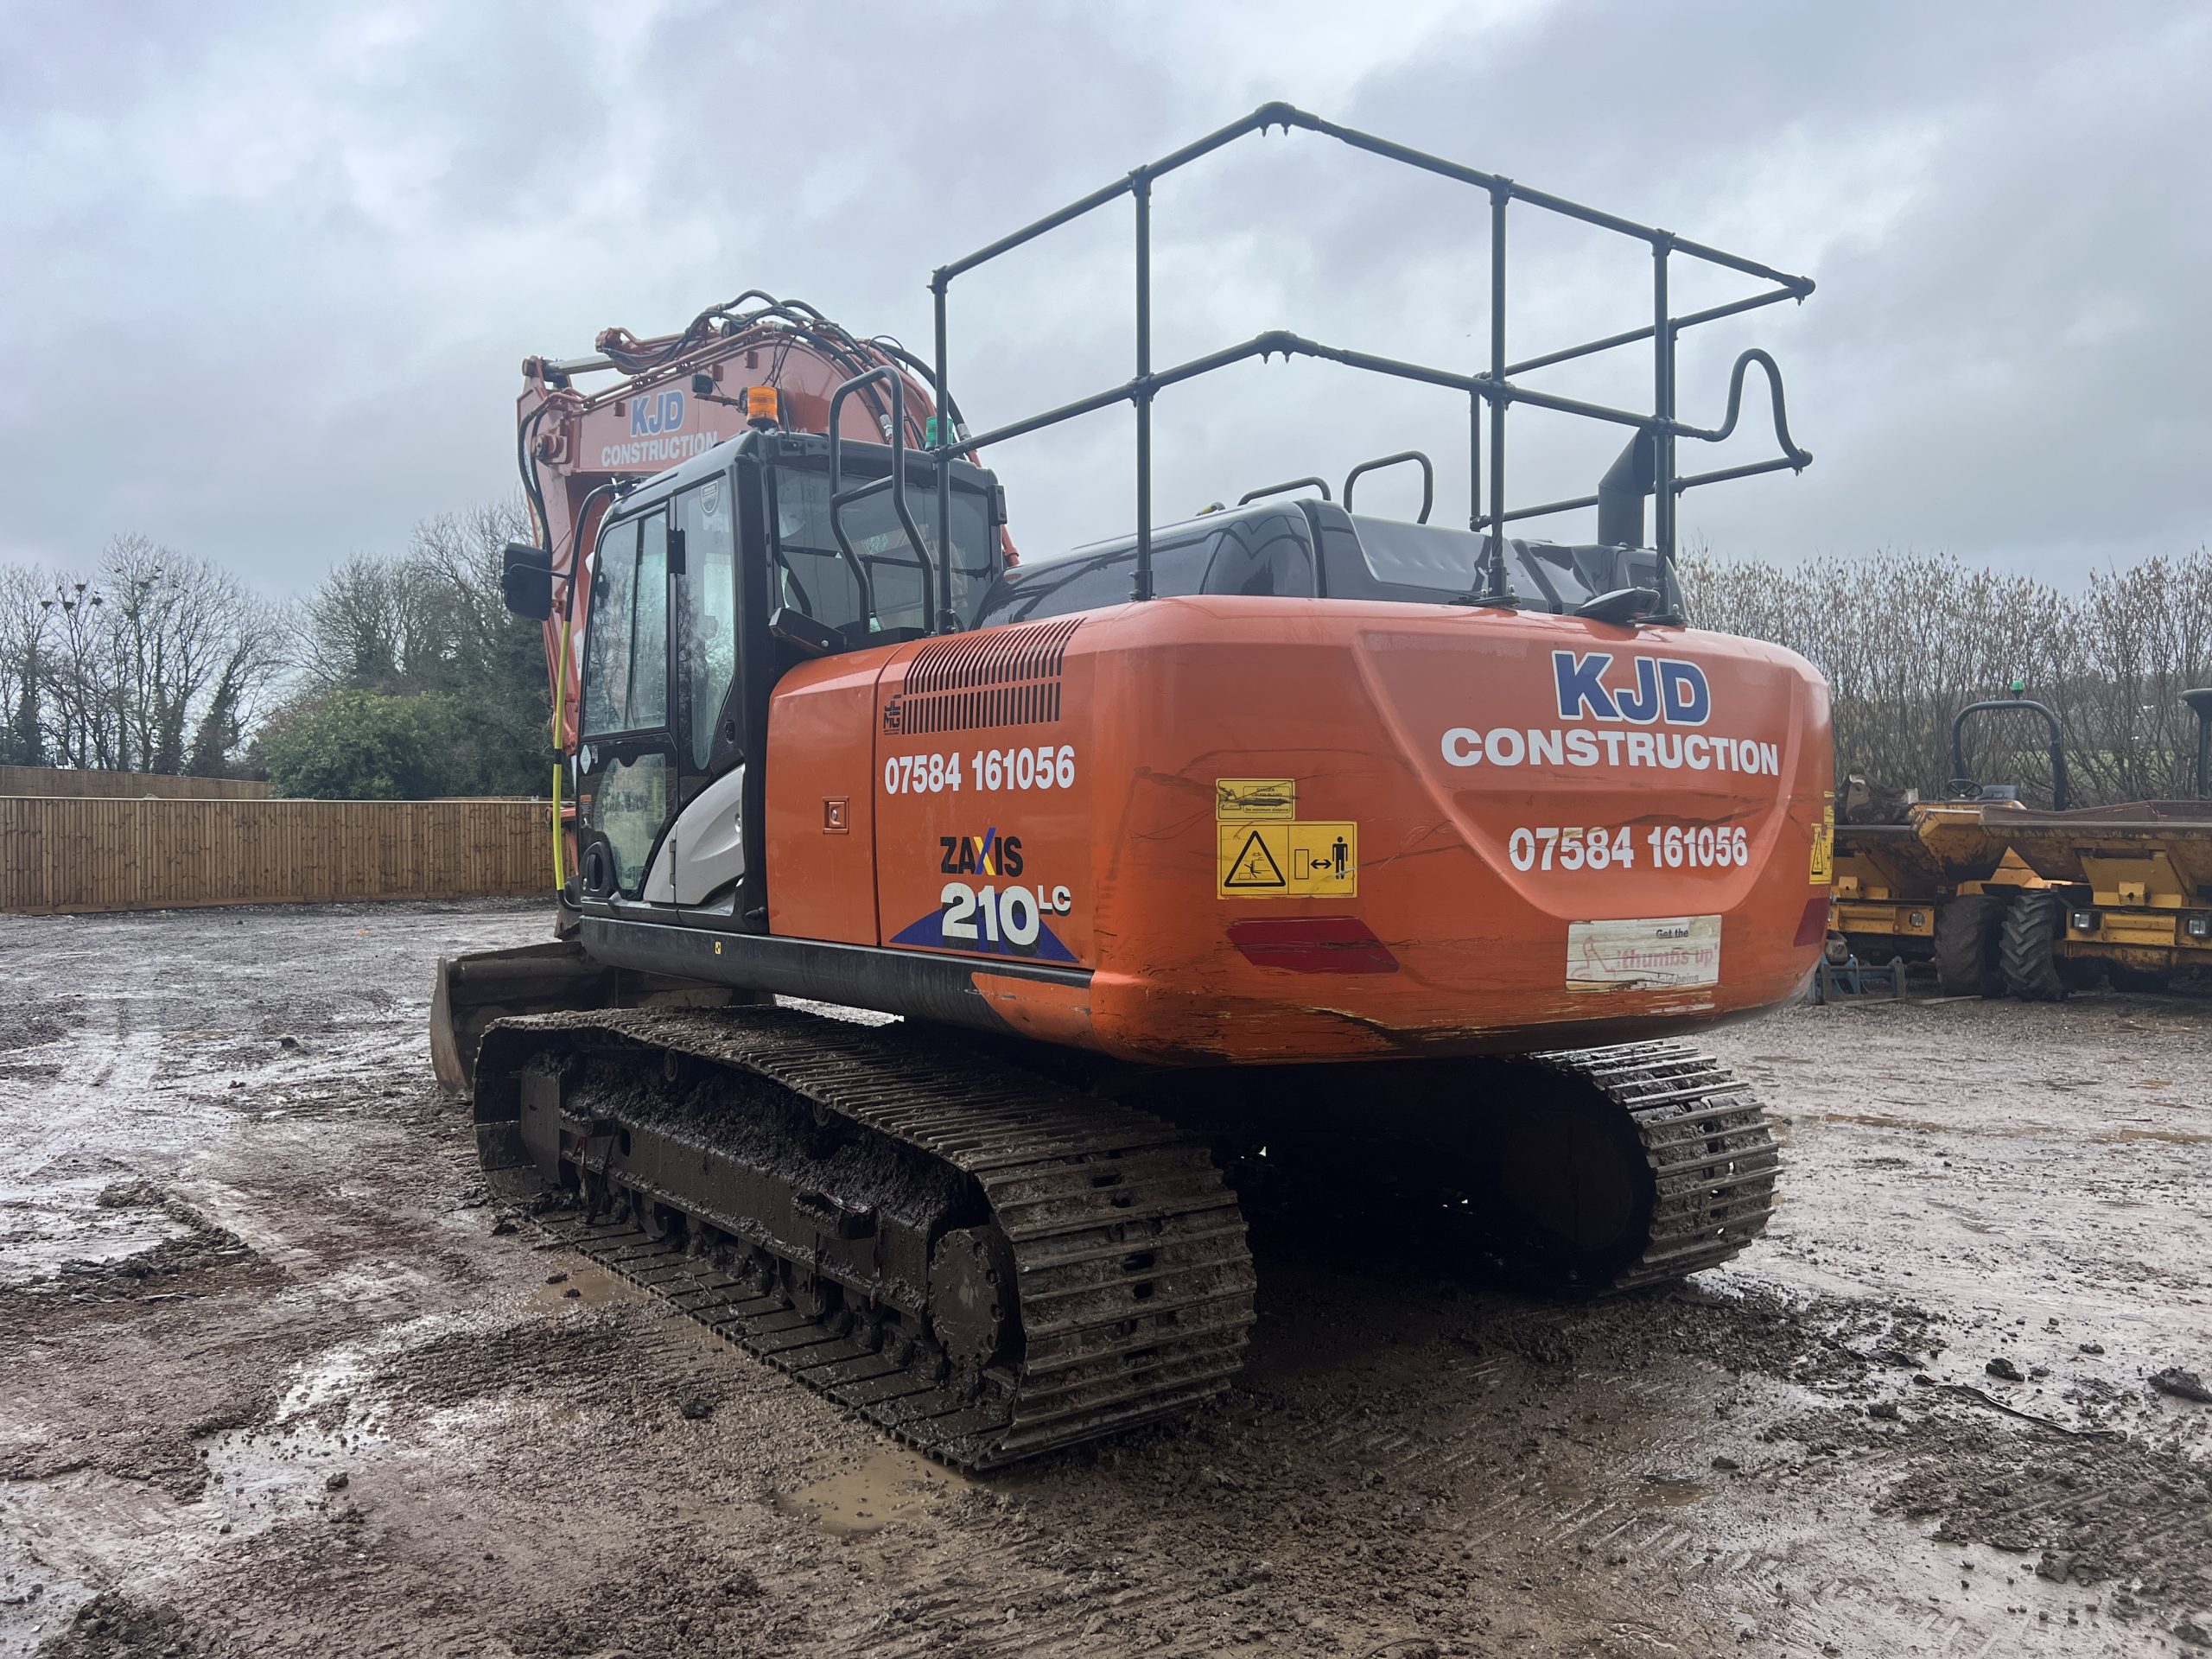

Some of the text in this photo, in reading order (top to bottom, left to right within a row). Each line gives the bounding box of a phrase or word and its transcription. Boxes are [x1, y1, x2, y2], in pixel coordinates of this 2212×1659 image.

[630, 390, 684, 438] KJD
[601, 431, 718, 467] CONSTRUCTION
[1552, 650, 1711, 726] KJD
[885, 745, 1075, 794] 07584 161056
[1440, 728, 1778, 776] CONSTRUCTION
[940, 827, 1023, 877] ZAXIS
[1509, 825, 1748, 871] 07584 161056
[1656, 928, 1689, 938] Get the
[1675, 973, 1700, 983] being
